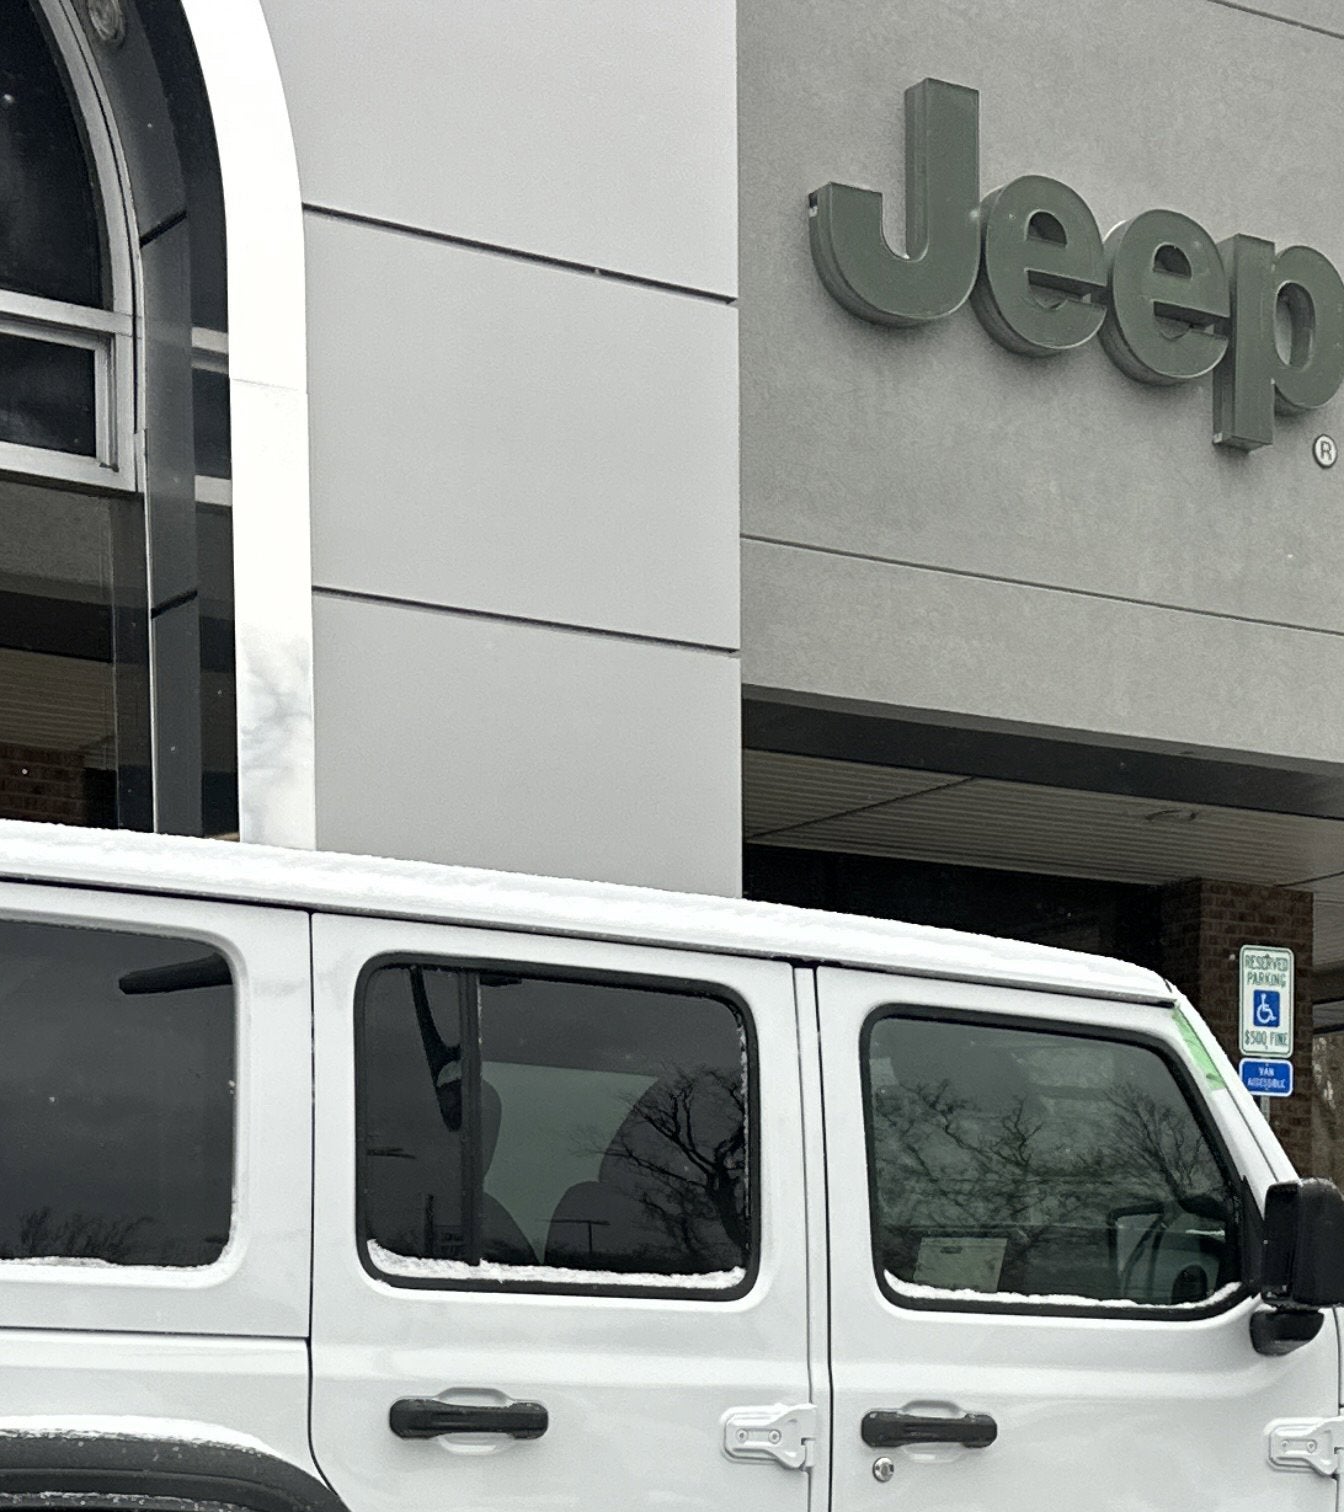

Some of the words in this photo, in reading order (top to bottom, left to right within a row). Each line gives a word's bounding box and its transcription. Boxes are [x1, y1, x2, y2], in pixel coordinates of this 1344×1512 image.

[1245, 954, 1289, 972] RESERVED
[1247, 971, 1287, 988] PARKING
[1269, 1031, 1288, 1047] FINE
[1258, 1066, 1275, 1077] VAN
